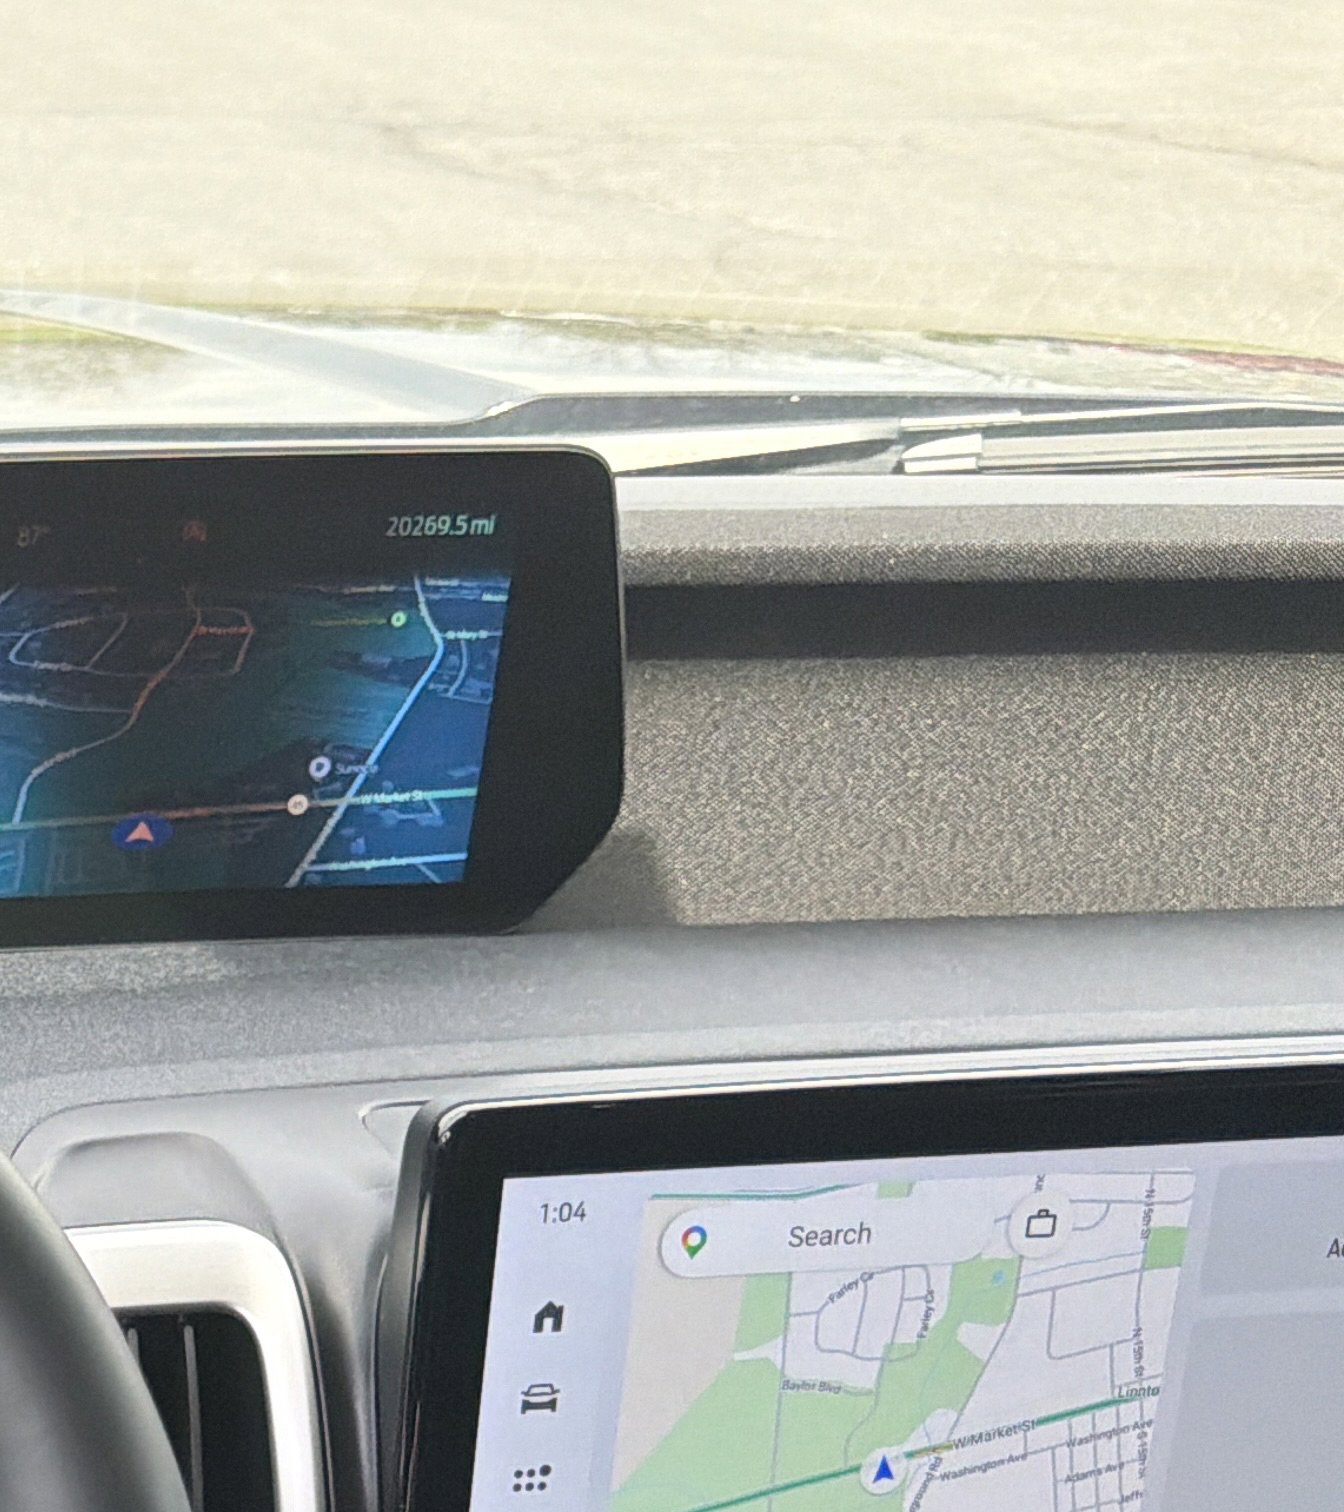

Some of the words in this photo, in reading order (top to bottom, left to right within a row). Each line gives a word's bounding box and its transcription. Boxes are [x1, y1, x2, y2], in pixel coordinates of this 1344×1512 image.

[386, 515, 465, 538] 20269.5
[469, 515, 496, 536] mi
[540, 1200, 587, 1224] 1:04
[788, 1221, 872, 1248] Search
[969, 1425, 1019, 1444] Market
[1021, 1419, 1037, 1431] St
[1065, 1425, 1130, 1448] Washington
[1130, 1419, 1153, 1431] Ave
[928, 1455, 943, 1473] Rd
[939, 1458, 1005, 1481] Washington
[1005, 1452, 1028, 1464] Ave
[1064, 1469, 1103, 1483] Adams
[1103, 1462, 1125, 1474] Ave
